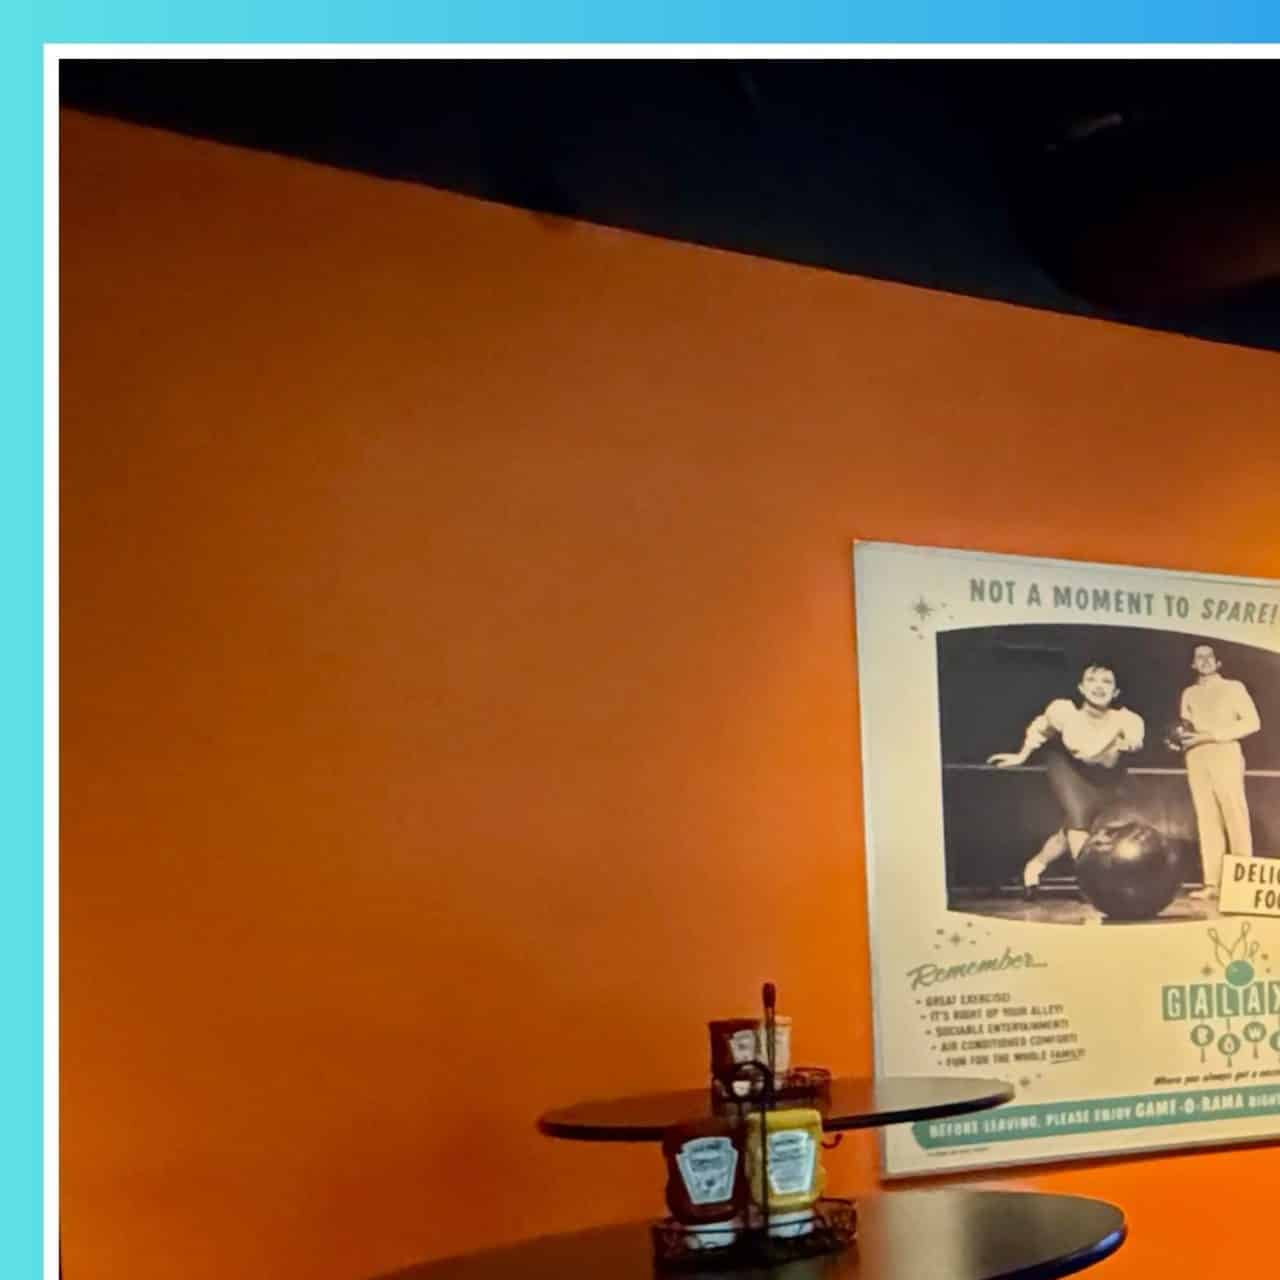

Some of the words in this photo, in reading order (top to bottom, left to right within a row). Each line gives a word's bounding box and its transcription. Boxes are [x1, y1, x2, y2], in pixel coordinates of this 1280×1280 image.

[969, 578, 1016, 605] NOT
[1026, 583, 1042, 607] A
[1053, 586, 1155, 617] MOMENT
[1164, 594, 1190, 619] TO
[1200, 597, 1280, 625] SPARE!
[953, 1008, 982, 1020] RIGHT
[986, 1007, 999, 1018] UP
[1003, 1006, 1027, 1017] YOUR
[935, 1024, 984, 1037] SOCIABLE
[941, 1041, 958, 1052] AIR
[961, 1036, 1027, 1051] CONDITIONED
[946, 1056, 967, 1067] FUN
[970, 1054, 989, 1065] FOR
[993, 1053, 1009, 1063] THE
[1013, 1050, 1046, 1061] WHOLE
[929, 1121, 979, 1139] BEFORE
[1045, 1108, 1090, 1127] PLEASE
[1094, 1105, 1132, 1122] ENJOY
[1135, 1092, 1245, 1120] GAME-O-RAMA
